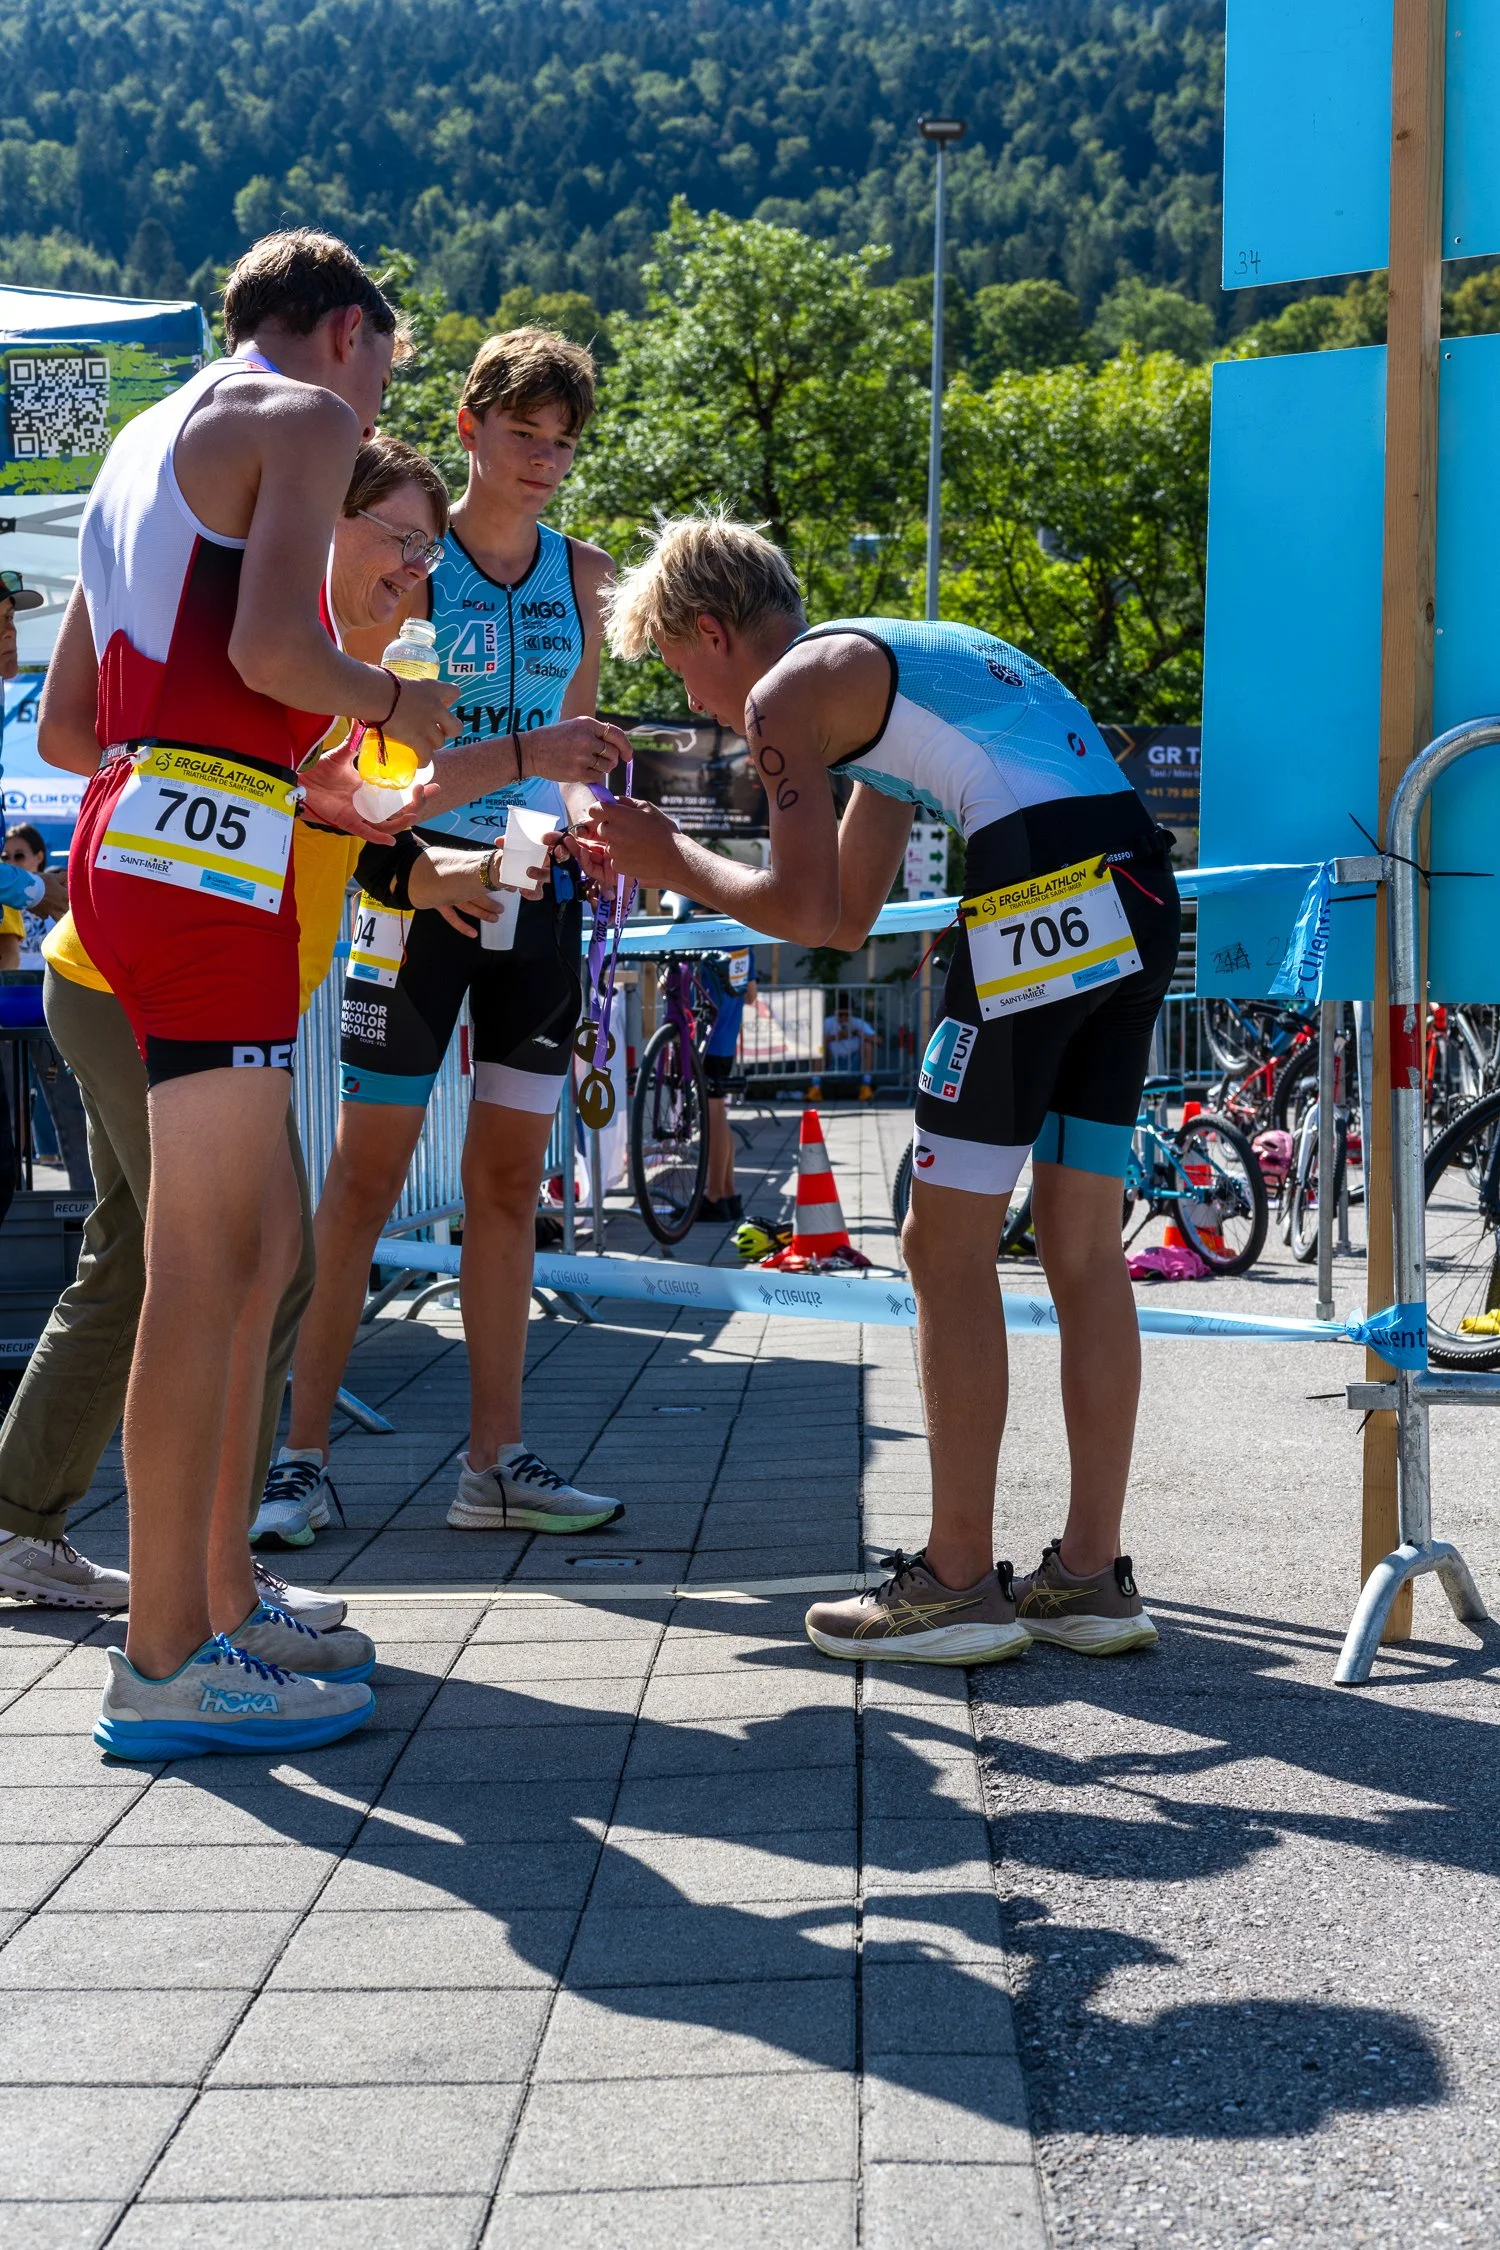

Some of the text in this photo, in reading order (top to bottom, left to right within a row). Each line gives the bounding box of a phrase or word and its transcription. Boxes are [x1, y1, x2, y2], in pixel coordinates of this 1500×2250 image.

[1233, 250, 1261, 276] 34
[520, 600, 567, 619] MGO
[451, 663, 474, 673] TRI
[485, 623, 495, 652] FUN
[541, 635, 572, 652] BCN
[1148, 745, 1200, 765] GR T
[183, 769, 218, 785] TRIATHLON
[218, 778, 228, 787] DE
[228, 781, 265, 798] SAINT-IMIER
[154, 788, 250, 851] 705
[119, 854, 169, 873] SAINT-IMIER
[1008, 895, 1041, 911] TRIATHLON
[1041, 893, 1050, 901] DE
[1050, 881, 1083, 898] SAINT-IMIER
[1000, 906, 1090, 967] 706
[1000, 988, 1046, 1007] SAINT-IMIER
[950, 1027, 974, 1071] FUN
[55, 1203, 89, 1213] RECUP
[200, 1688, 280, 1713] HOKA
